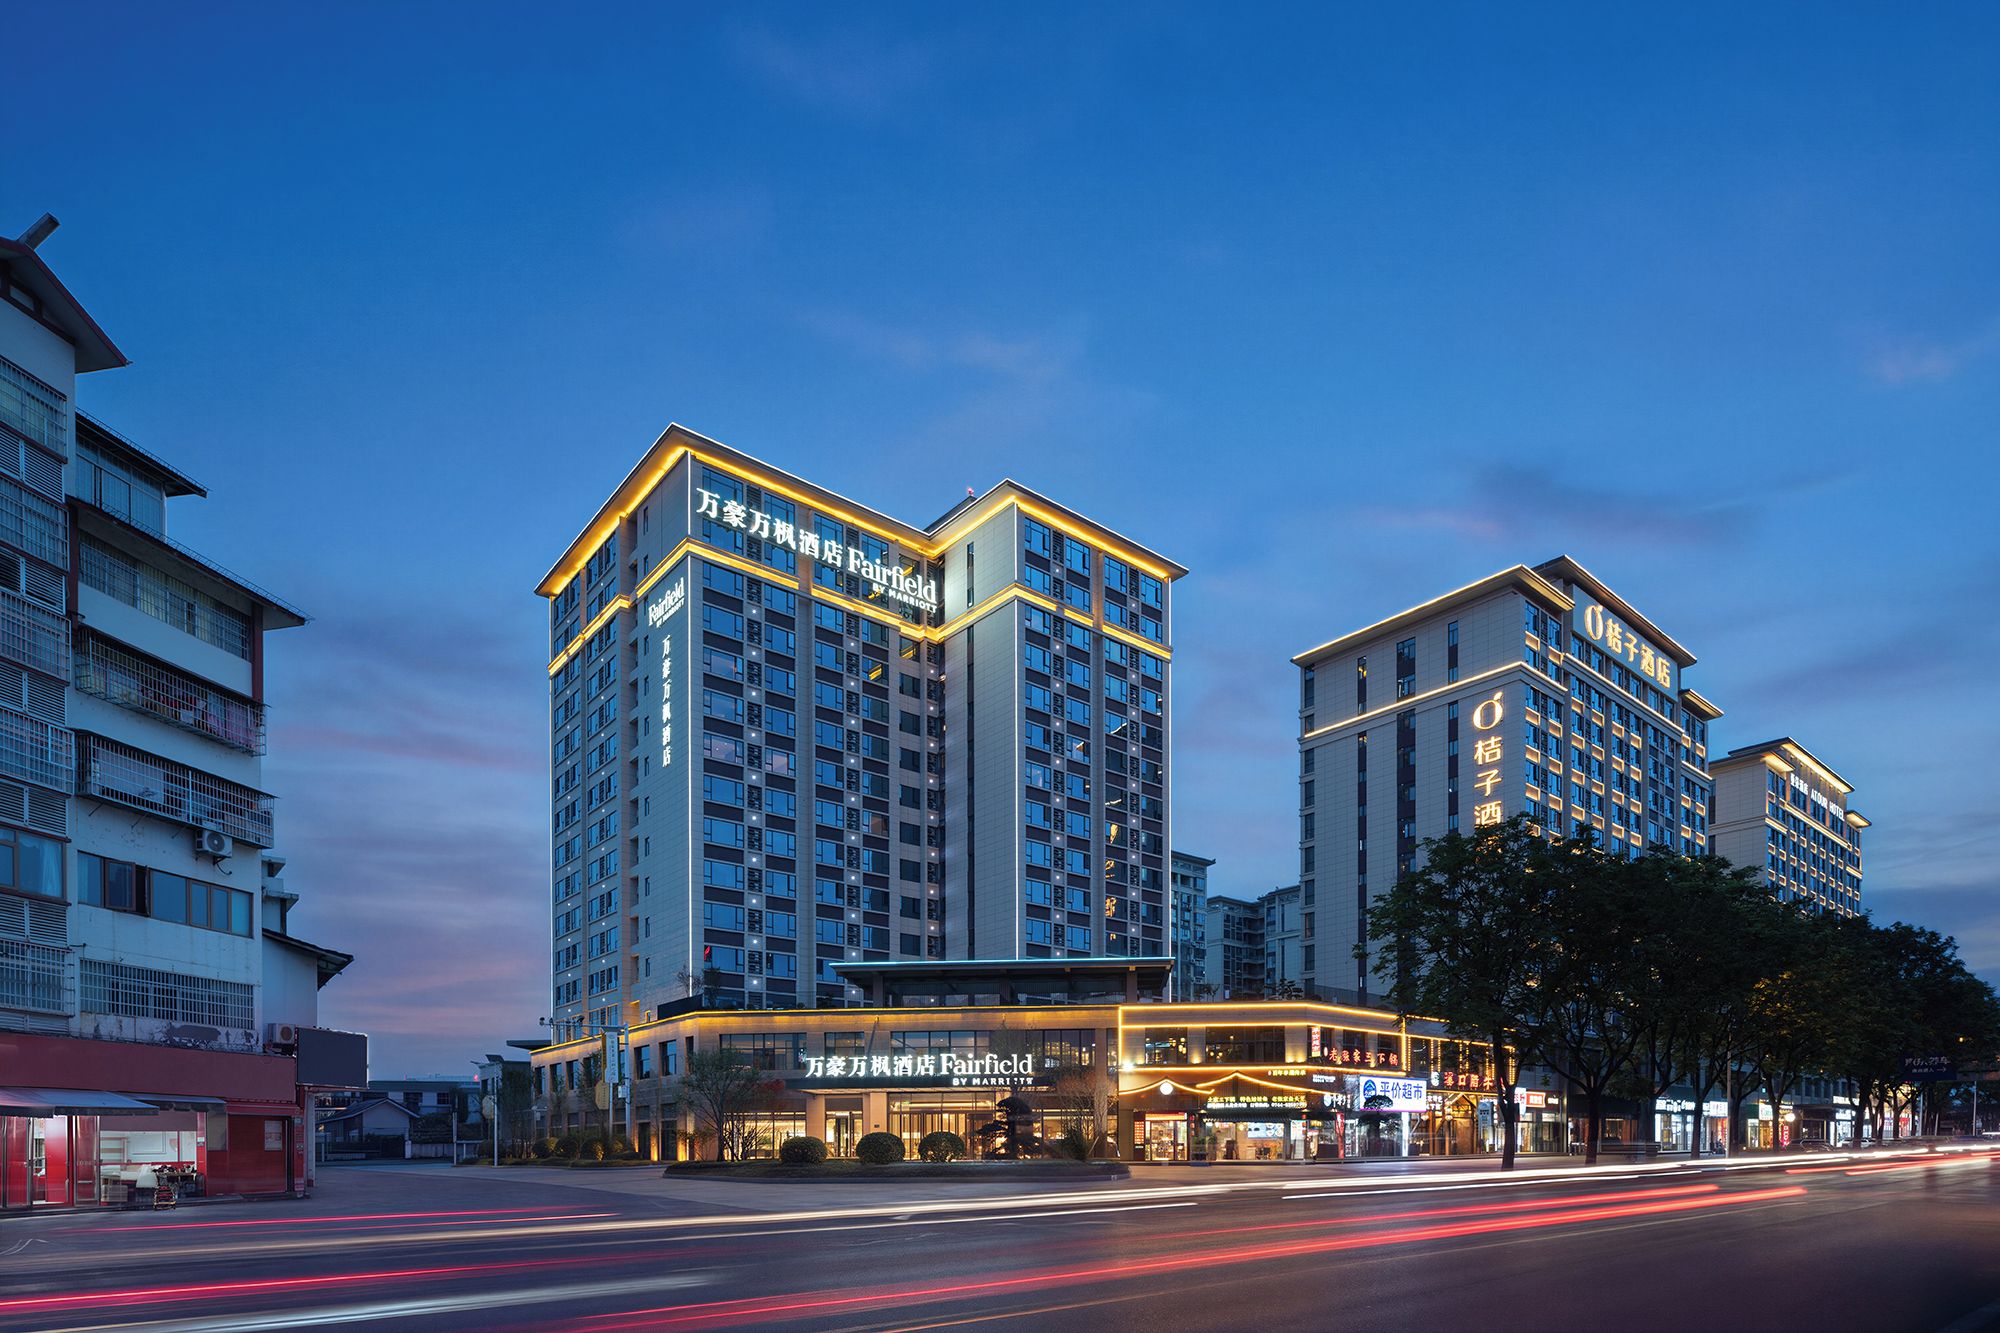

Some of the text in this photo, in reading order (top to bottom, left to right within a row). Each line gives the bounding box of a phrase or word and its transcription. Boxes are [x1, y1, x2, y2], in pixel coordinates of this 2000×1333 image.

[696, 488, 843, 568] 万豪万枫酒店
[847, 546, 938, 604] Fairfield
[648, 577, 685, 626] Fairfield
[873, 583, 938, 613] BY MARRIOTT
[1605, 618, 1671, 689] 桔子酒店
[662, 634, 672, 768] 万豪万枫酒店
[1811, 789, 1845, 821] ATOUR HOTEL
[805, 1055, 935, 1077] 万豪万枫酒店
[940, 1053, 1033, 1075] Fairfield
[952, 1077, 967, 1086] BY
[1380, 1081, 1423, 1099] 平价超市
